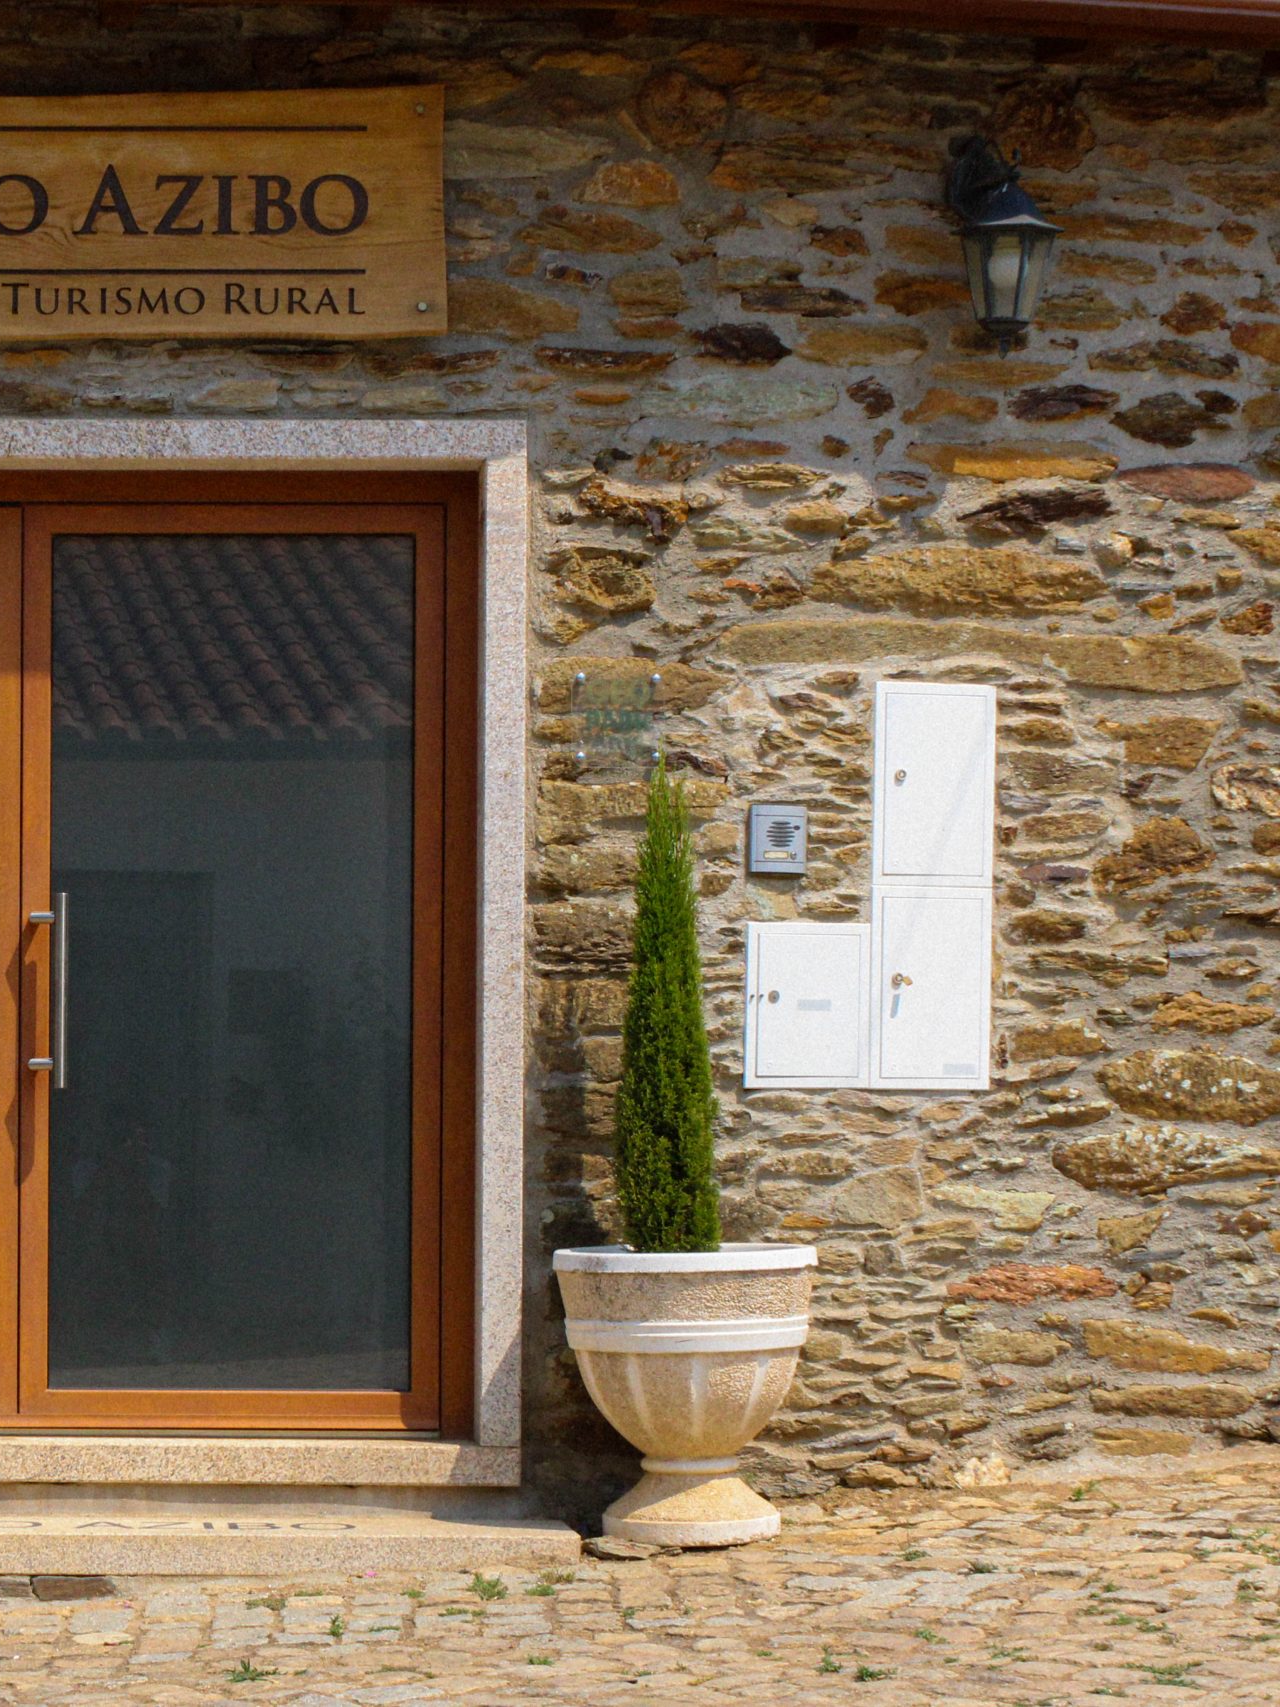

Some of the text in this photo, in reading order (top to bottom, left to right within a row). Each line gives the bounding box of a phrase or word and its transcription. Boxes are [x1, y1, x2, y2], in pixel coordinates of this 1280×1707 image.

[72, 163, 369, 236] AZIBO
[1, 282, 366, 316] TURISMO RURAL
[74, 1520, 357, 1531] AZIBO
